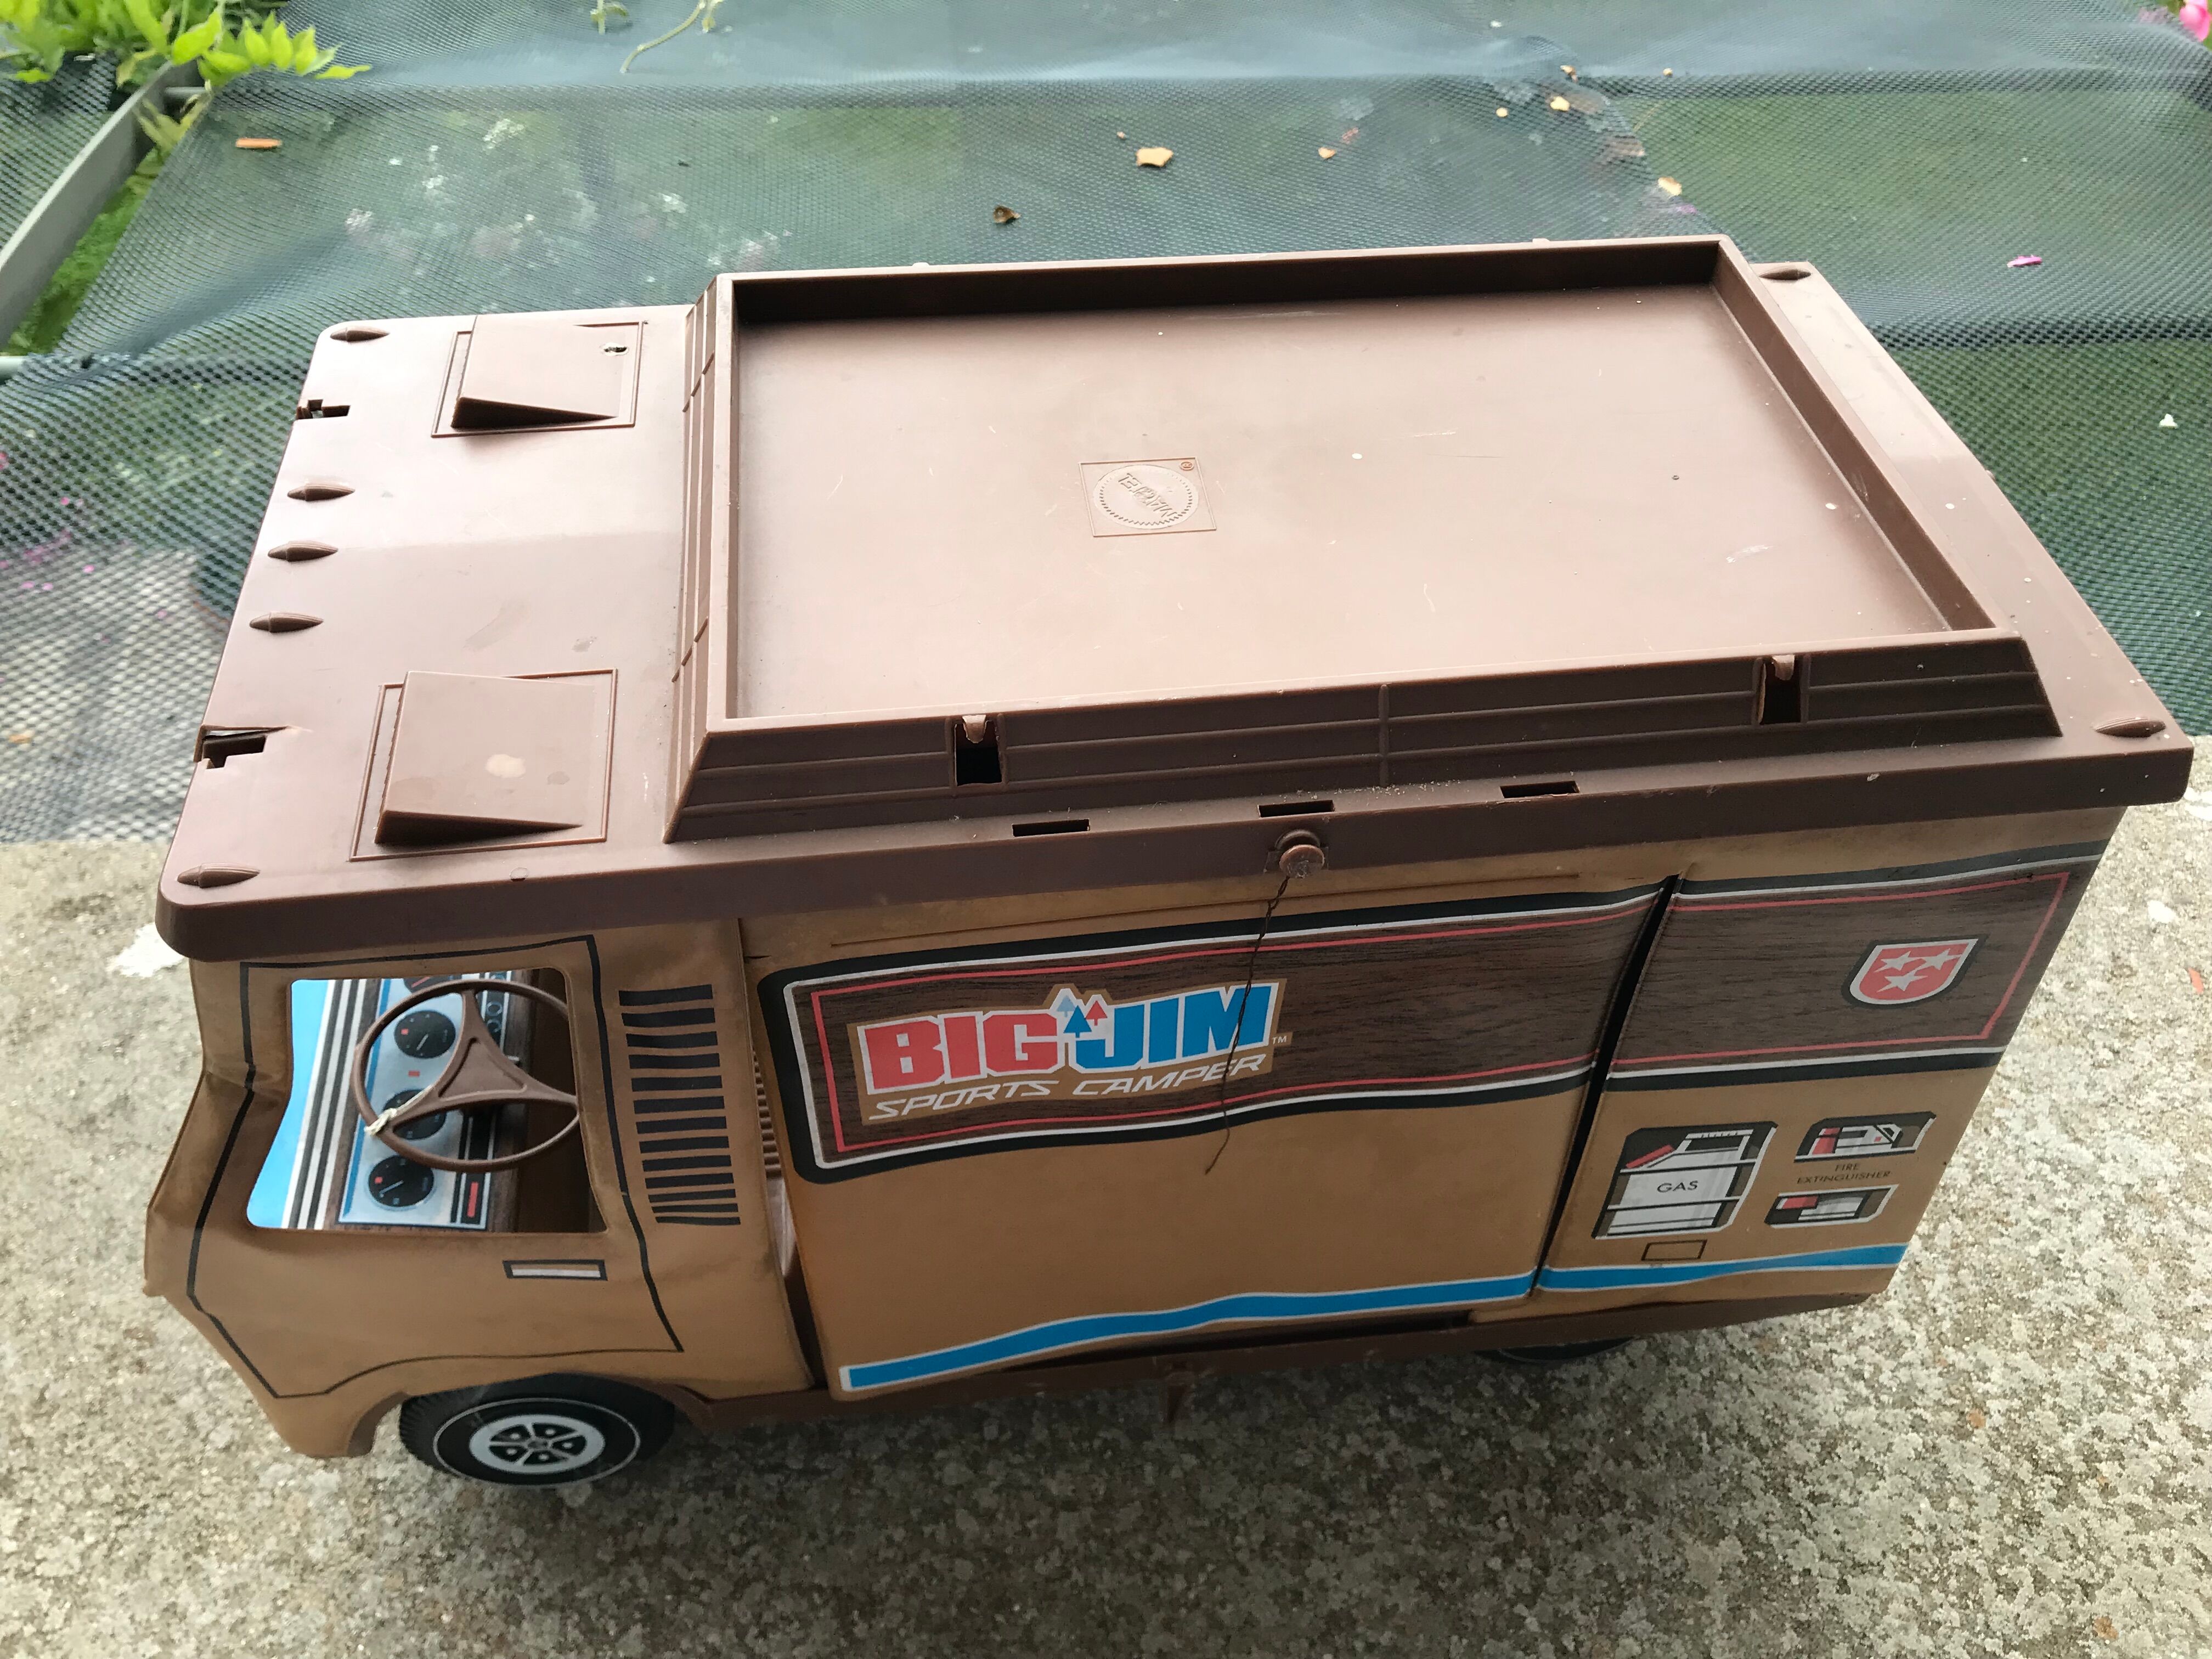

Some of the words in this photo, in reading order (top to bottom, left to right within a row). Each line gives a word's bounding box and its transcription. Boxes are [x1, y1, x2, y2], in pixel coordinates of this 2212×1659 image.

[1118, 473, 1177, 518] MATEL
[858, 1010, 1064, 1094] BIG
[1069, 983, 1279, 1072] JIM
[1272, 1036, 1287, 1045] TM
[869, 1081, 1059, 1120] SPORTS
[1073, 1054, 1266, 1096] CAMPER
[1797, 1171, 1891, 1184] EXTINGUISHER
[1835, 1163, 1860, 1172] FIRE
[1657, 1180, 1698, 1193] GAS
